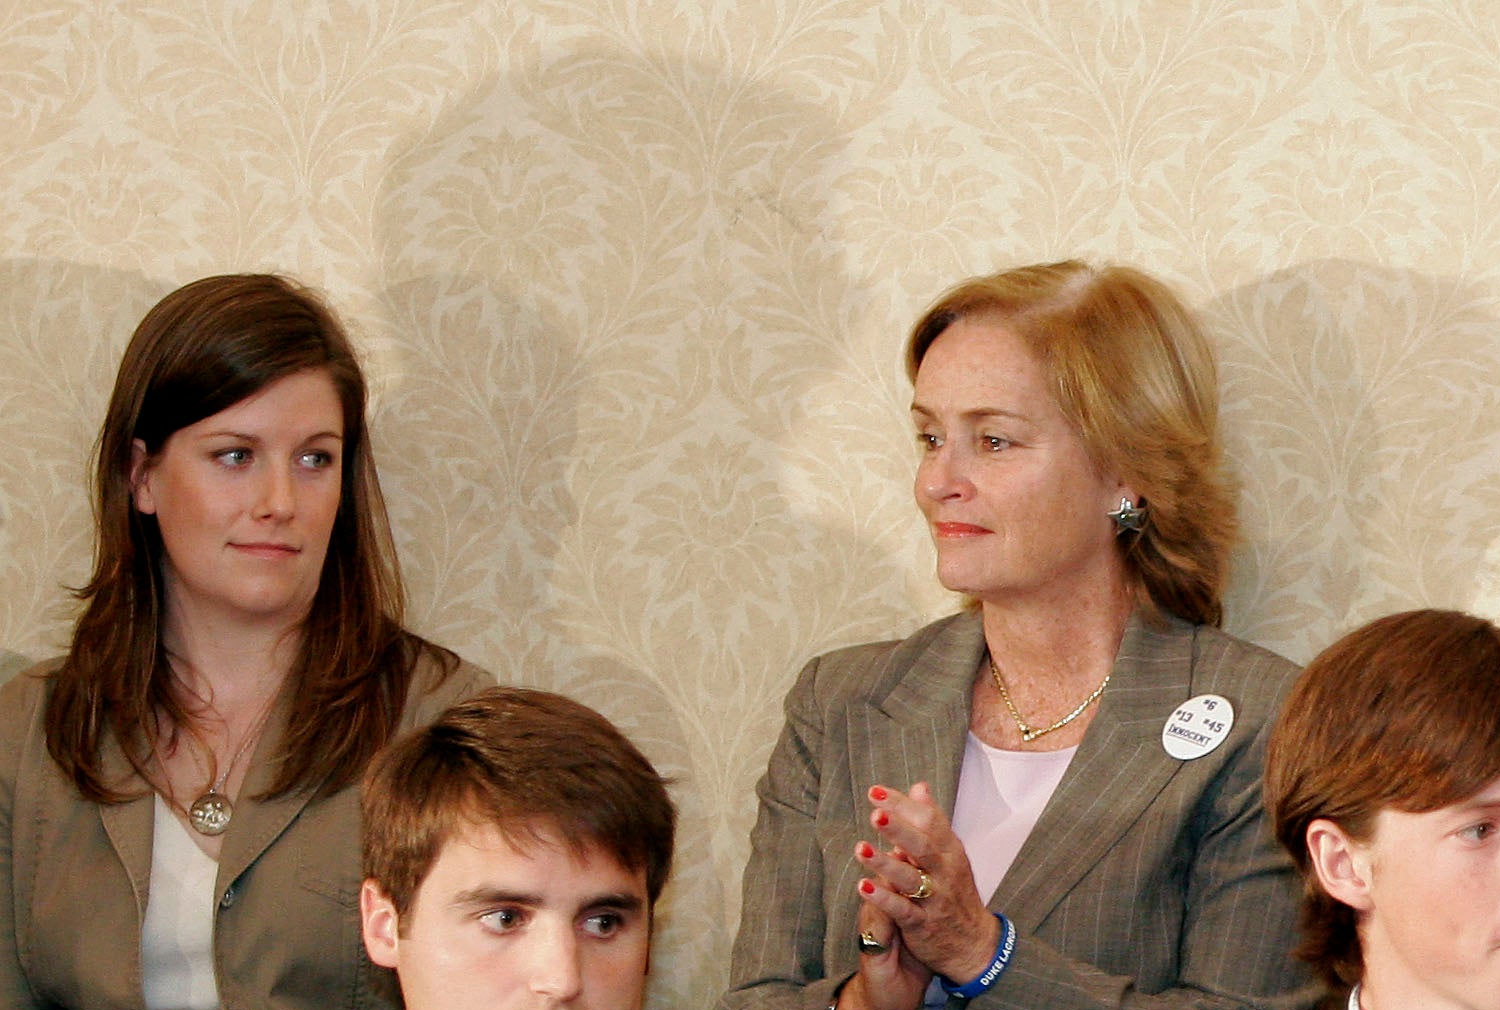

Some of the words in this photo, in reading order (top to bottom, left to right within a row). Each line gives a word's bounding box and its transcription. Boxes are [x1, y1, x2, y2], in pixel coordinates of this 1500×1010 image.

[1203, 700, 1218, 711] #6
[1176, 710, 1194, 722] #13
[1203, 719, 1225, 733] #45
[979, 960, 1005, 986] DUKE
